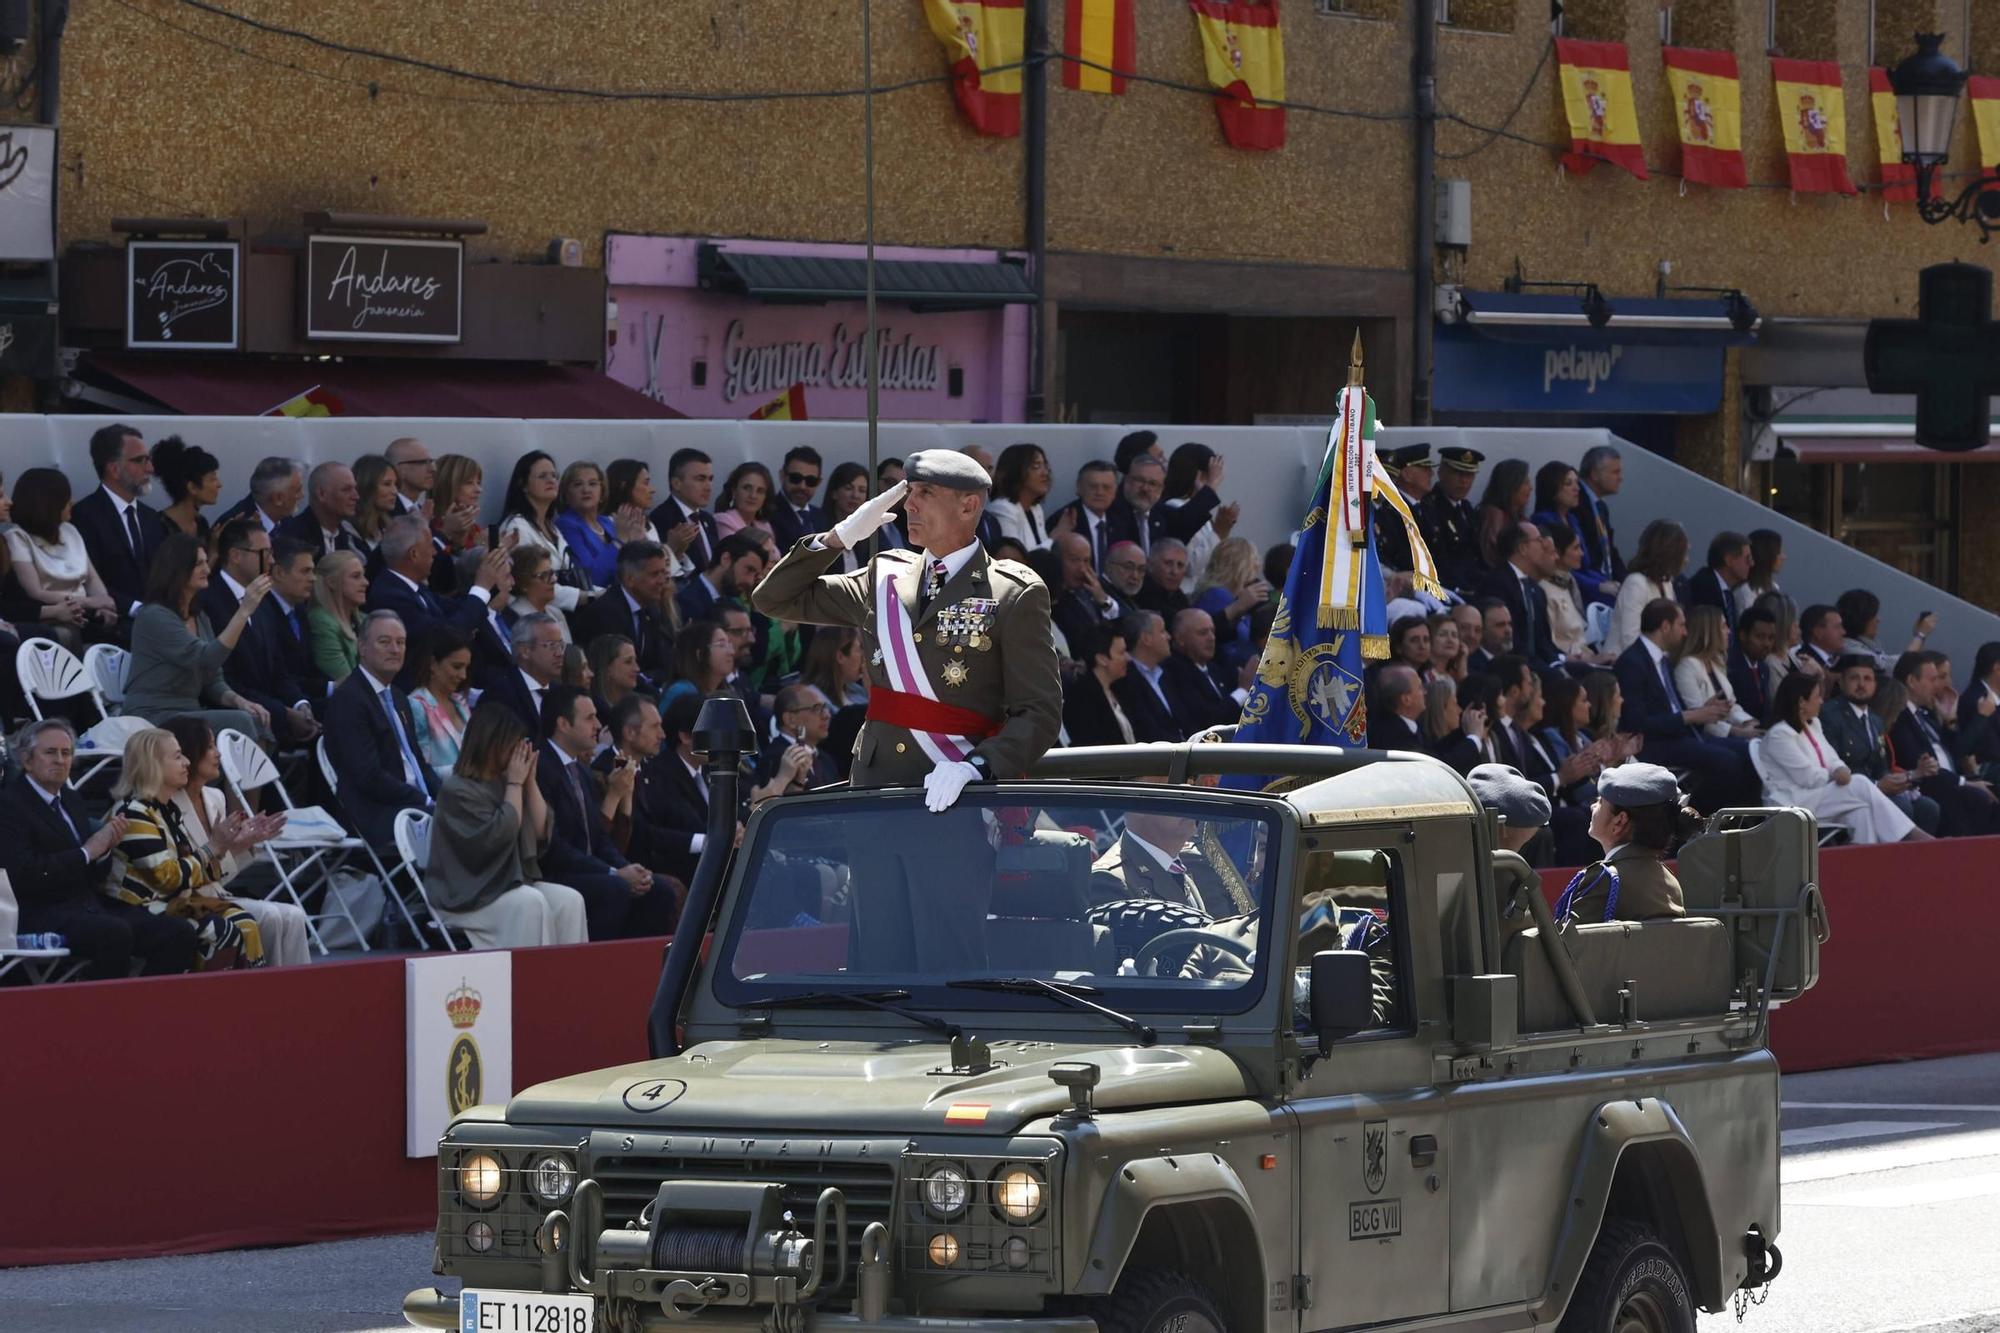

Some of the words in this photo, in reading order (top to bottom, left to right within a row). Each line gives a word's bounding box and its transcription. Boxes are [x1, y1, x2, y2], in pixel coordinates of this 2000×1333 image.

[147, 268, 225, 301] Andares
[328, 245, 441, 306] Andares
[724, 319, 826, 403] Gemma
[1544, 345, 1611, 394] pelayo
[1349, 435, 1354, 443] EN
[640, 1082, 667, 1104] 4
[619, 1135, 873, 1156] SANTANA
[1353, 1208, 1379, 1232] BCG
[1382, 1206, 1398, 1229] VII
[466, 1319, 474, 1329] E
[480, 1302, 505, 1330] ET
